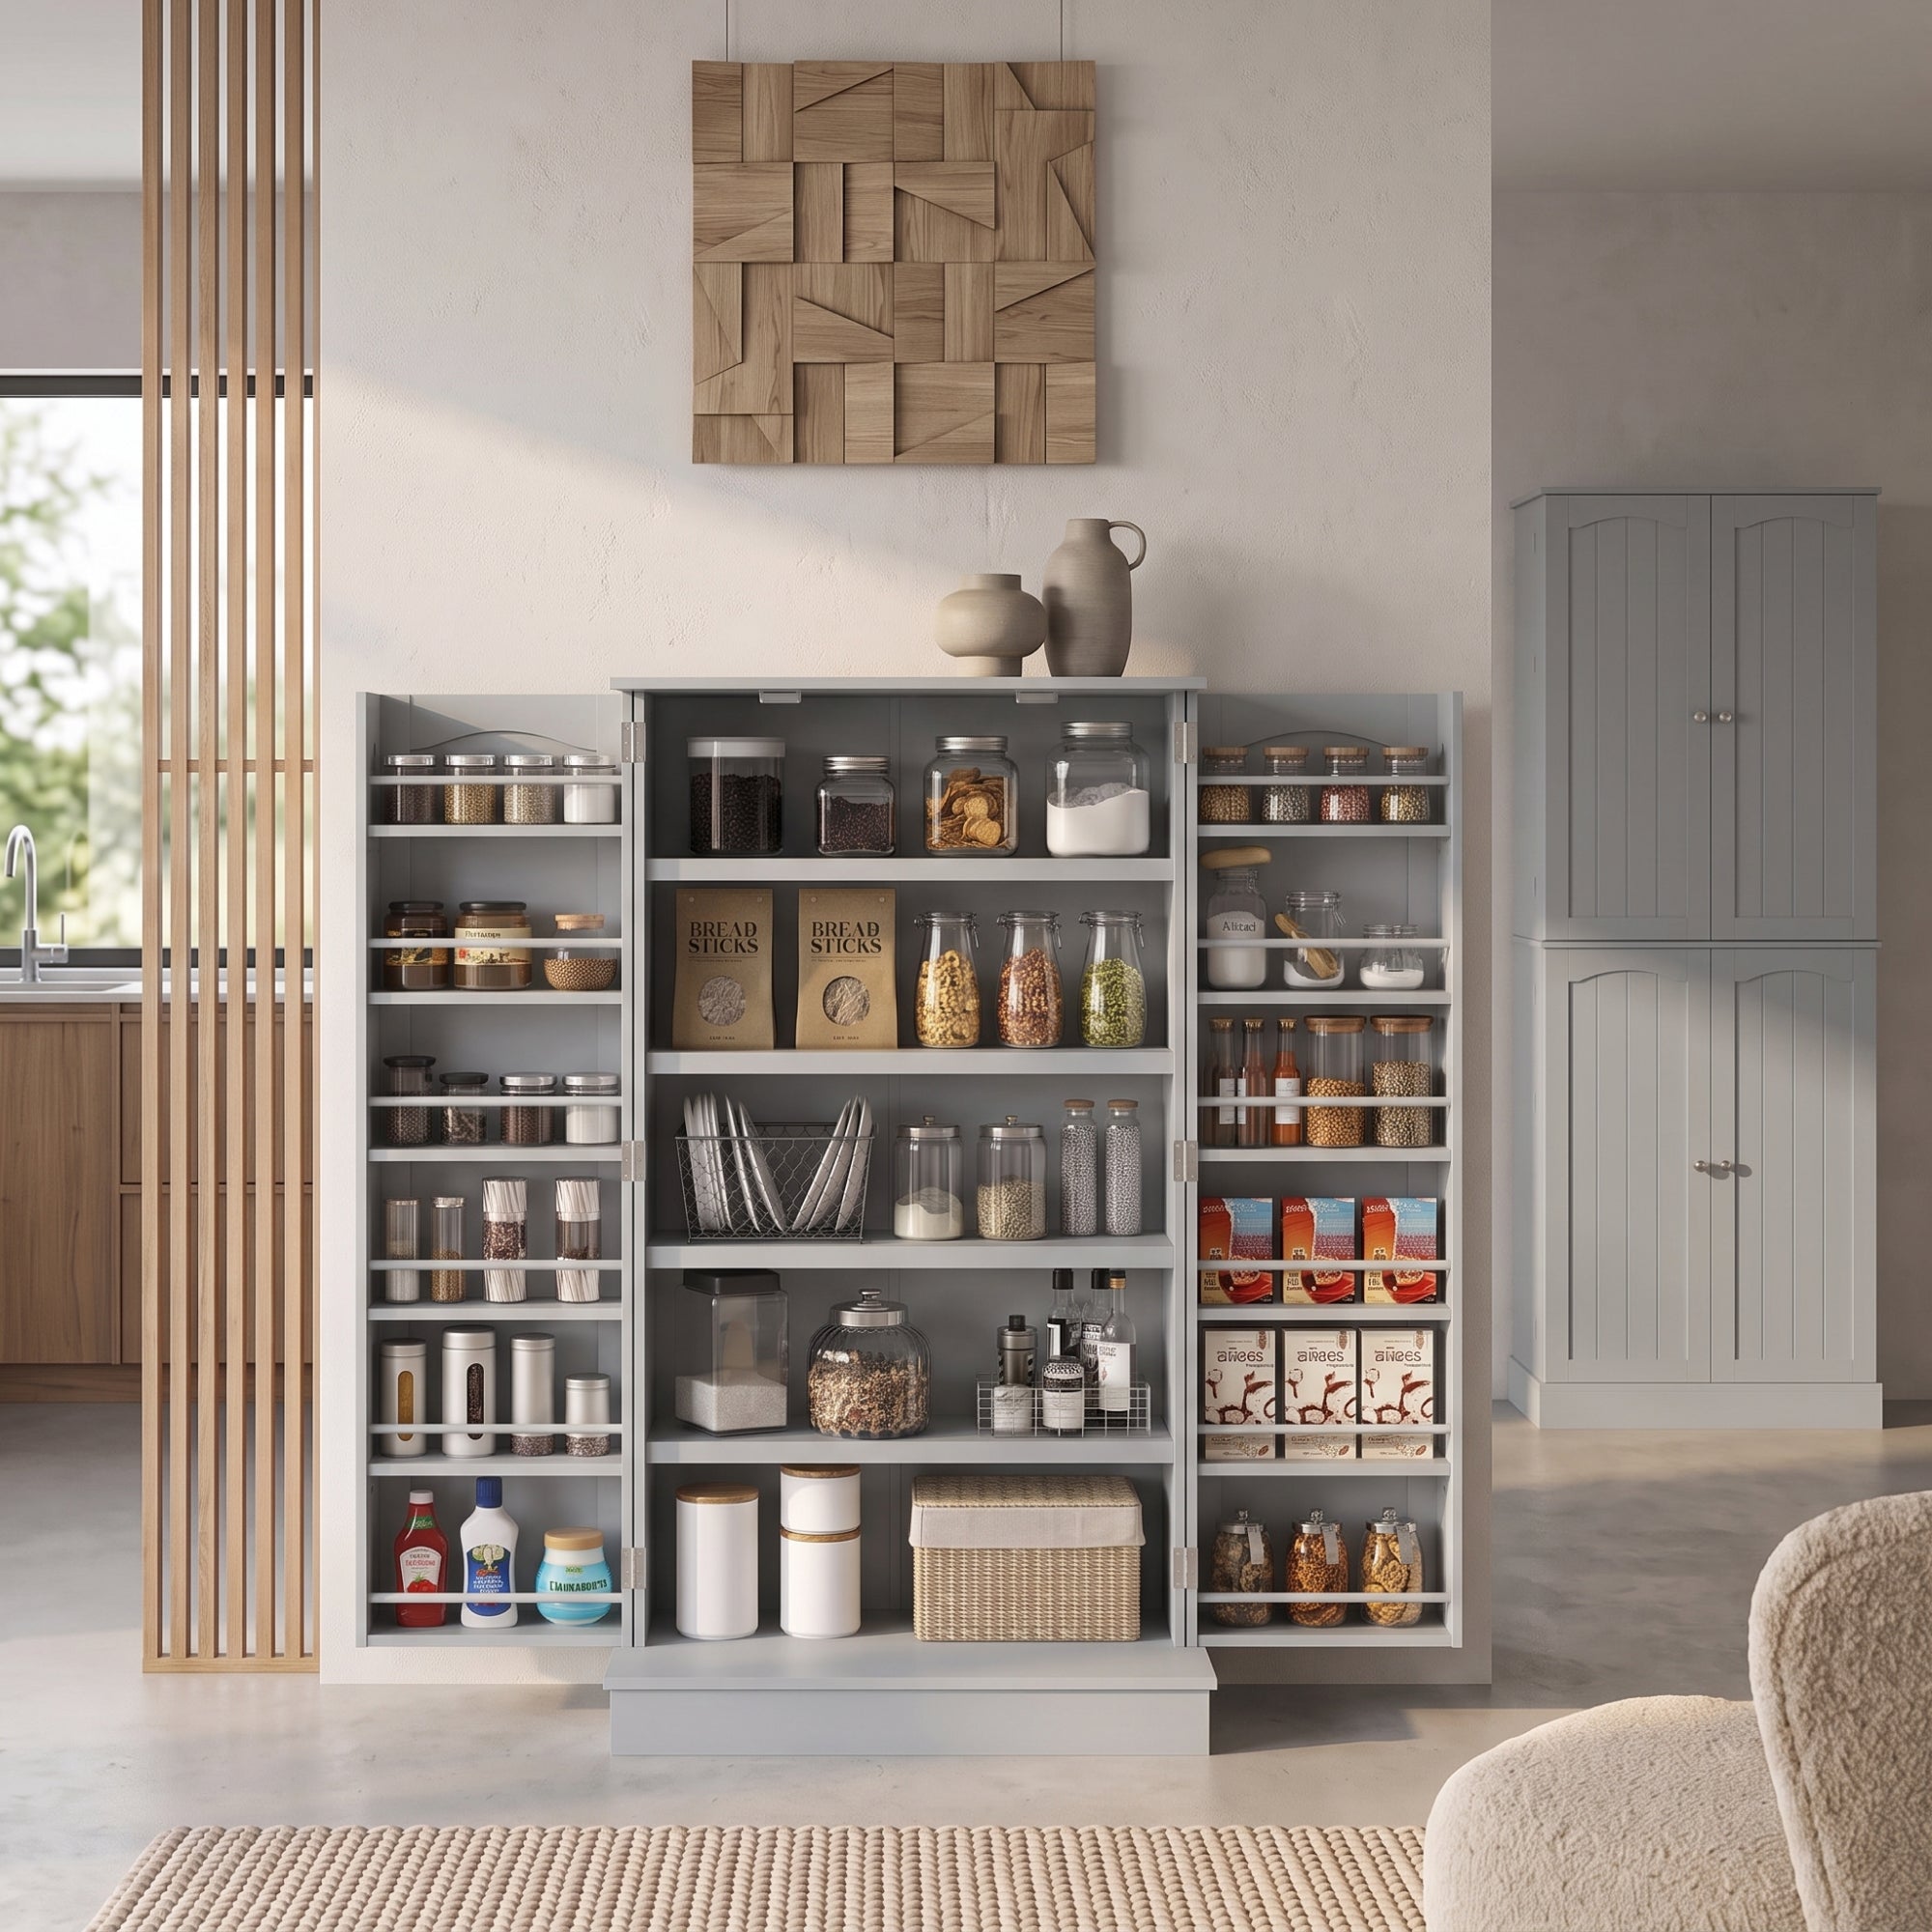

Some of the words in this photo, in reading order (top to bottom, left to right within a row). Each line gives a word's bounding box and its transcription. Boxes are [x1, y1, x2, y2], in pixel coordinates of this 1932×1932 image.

[690, 921, 757, 937] BREAD
[811, 921, 880, 937] BREAD
[688, 938, 758, 953] STICKS
[810, 938, 882, 953] STICKS
